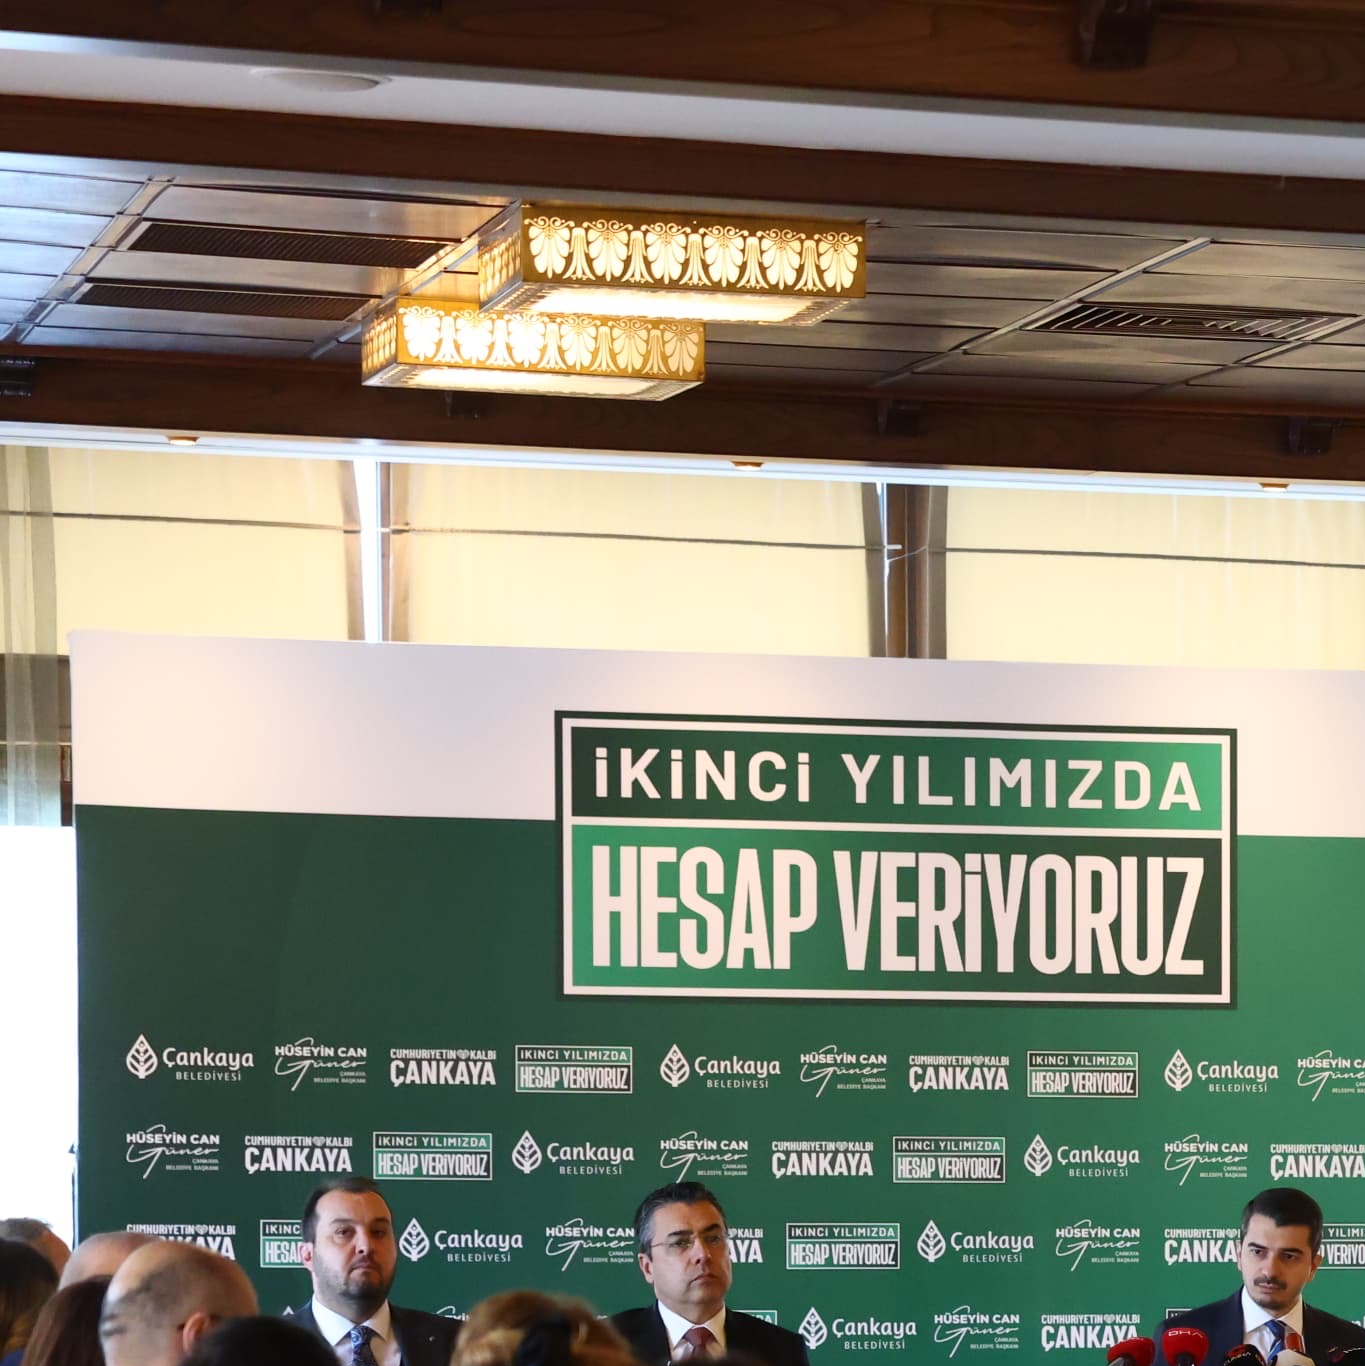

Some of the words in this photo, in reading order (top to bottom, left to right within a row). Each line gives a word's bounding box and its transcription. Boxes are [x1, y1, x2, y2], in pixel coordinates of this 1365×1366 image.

[841, 754, 1201, 811] YILIMIZDA
[592, 845, 817, 969] HESAP
[833, 850, 1204, 975] VERİYORUZ
[275, 1044, 334, 1057] HÜSEYİN
[337, 1047, 367, 1057] CAN
[563, 1050, 627, 1061] YILIMIZDA
[162, 1047, 254, 1071] Çankaya
[800, 1052, 856, 1064] HÜSEYİN
[859, 1054, 887, 1064] CAN
[1073, 1056, 1133, 1066] YILIMIZDA
[1297, 1057, 1351, 1068] HÜSEYİN
[390, 1060, 496, 1087] ÇANKAYA
[694, 1056, 781, 1078] Çankaya
[1197, 1060, 1279, 1082] Çankaya
[176, 1070, 241, 1081] BELEDİYESİ
[520, 1066, 560, 1088] HESAP
[909, 1066, 1009, 1093] ÇANKAYA
[707, 1078, 768, 1088] BELEDİYESİ
[1032, 1072, 1069, 1093] HESAP
[1209, 1082, 1267, 1092] BELEDİYESİ
[126, 1131, 187, 1144] HÜSEYİN
[190, 1134, 220, 1144] CAN
[422, 1137, 487, 1147] YILIMIZDA
[660, 1138, 717, 1150] HÜSEYİN
[720, 1140, 748, 1150] CAN
[939, 1141, 1000, 1151] YILIMIZDA
[1164, 1141, 1218, 1152] HÜSEYİN
[1221, 1143, 1248, 1152] CAN
[547, 1142, 634, 1165] Çankaya
[1057, 1145, 1140, 1167] Çankaya
[245, 1147, 352, 1174] ÇANKAYA
[378, 1153, 419, 1175] HESAP
[772, 1152, 873, 1179] ÇANKAYA
[559, 1164, 622, 1175] BELEDİYESİ
[897, 1157, 936, 1178] HESAP
[1069, 1167, 1128, 1177] BELEDİYESİ
[265, 1224, 301, 1234] İKİNC
[546, 1225, 603, 1237] HÜSEYİN
[606, 1227, 635, 1237] CAN
[833, 1227, 895, 1237] YILIMIZDA
[1056, 1226, 1110, 1238] HÜSEYİN
[1113, 1228, 1140, 1238] CAN
[434, 1229, 523, 1252] Çankaya
[950, 1231, 1034, 1253] Çankaya
[265, 1242, 302, 1263] HESA
[447, 1252, 511, 1262] BELEDİYESİ
[791, 1244, 829, 1265] HESAP
[962, 1252, 1022, 1263] BELEDİYESİ
[1164, 1240, 1240, 1266] ÇANKA
[934, 1312, 989, 1324] HÜSEYİN
[992, 1314, 1020, 1324] CAN
[832, 1317, 917, 1339] Çankaya
[844, 1339, 905, 1350] BELEDİYESİ
